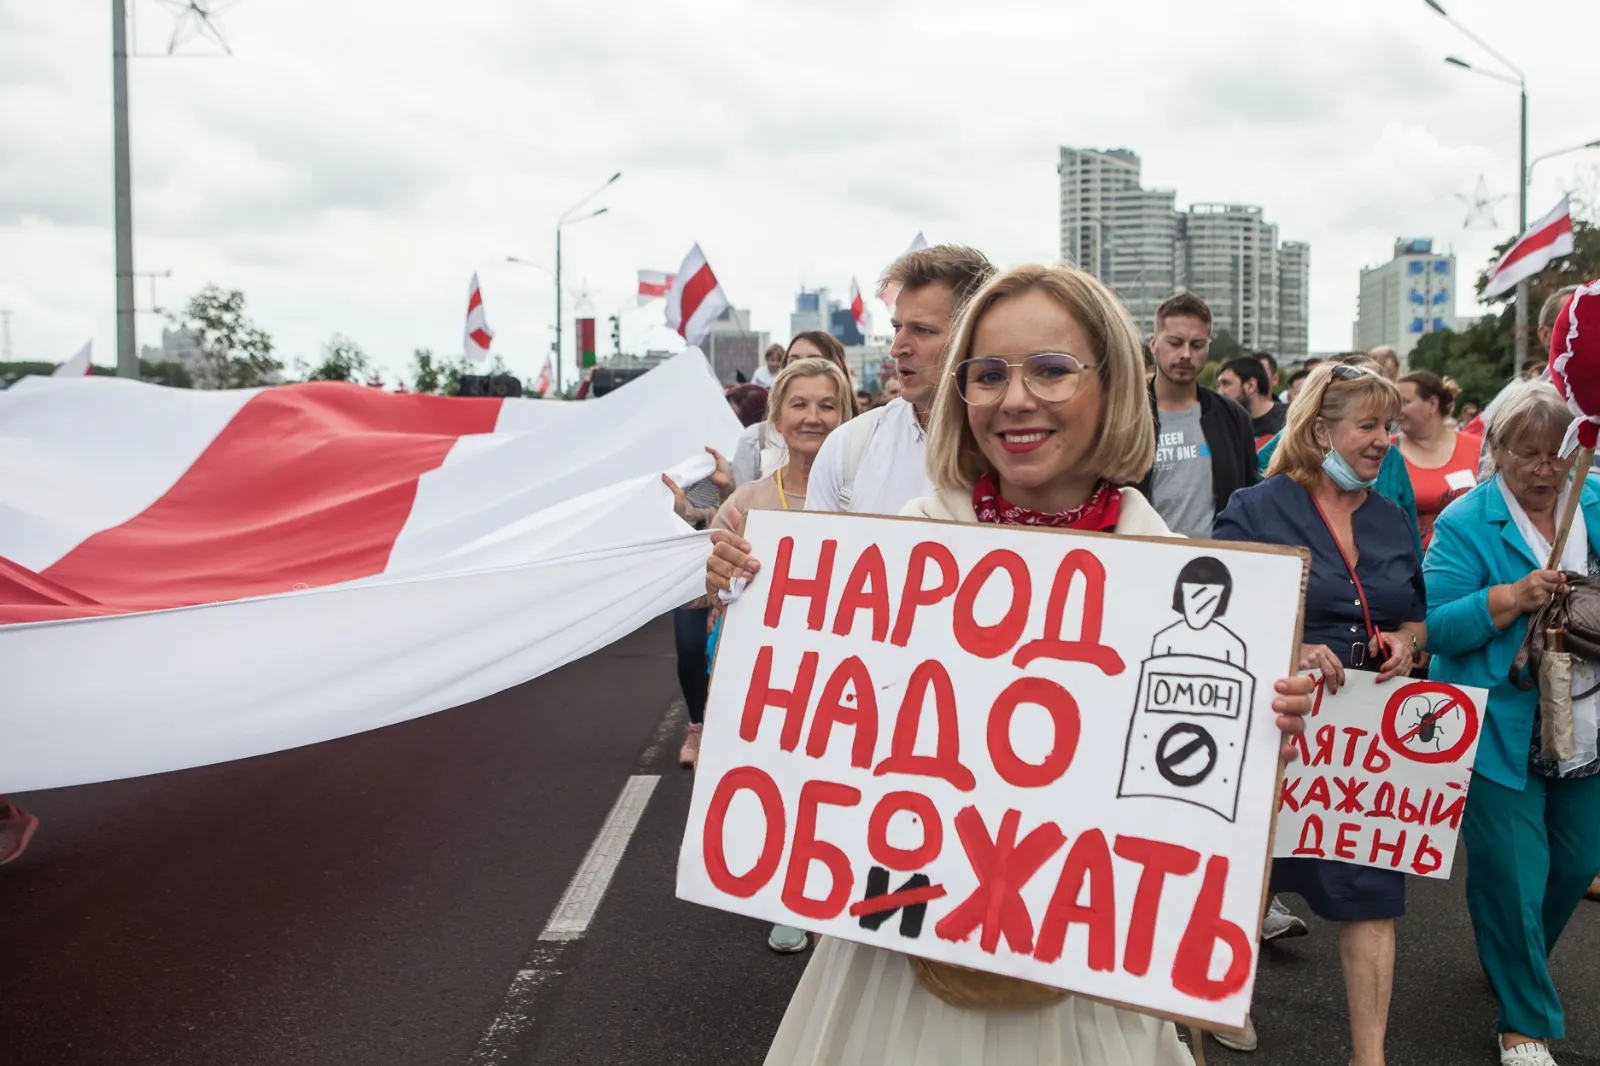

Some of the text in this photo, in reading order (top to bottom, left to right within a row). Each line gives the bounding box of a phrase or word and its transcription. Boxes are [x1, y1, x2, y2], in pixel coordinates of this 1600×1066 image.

[1157, 431, 1184, 447] TEEN
[1177, 445, 1198, 461] ONE
[763, 536, 1126, 676] НАРОД
[740, 645, 1081, 792] НАДО
[1154, 679, 1232, 711] ОМОН
[1278, 776, 1466, 830] КАЖДЫЙ
[1292, 814, 1442, 875] ДЕНЬ
